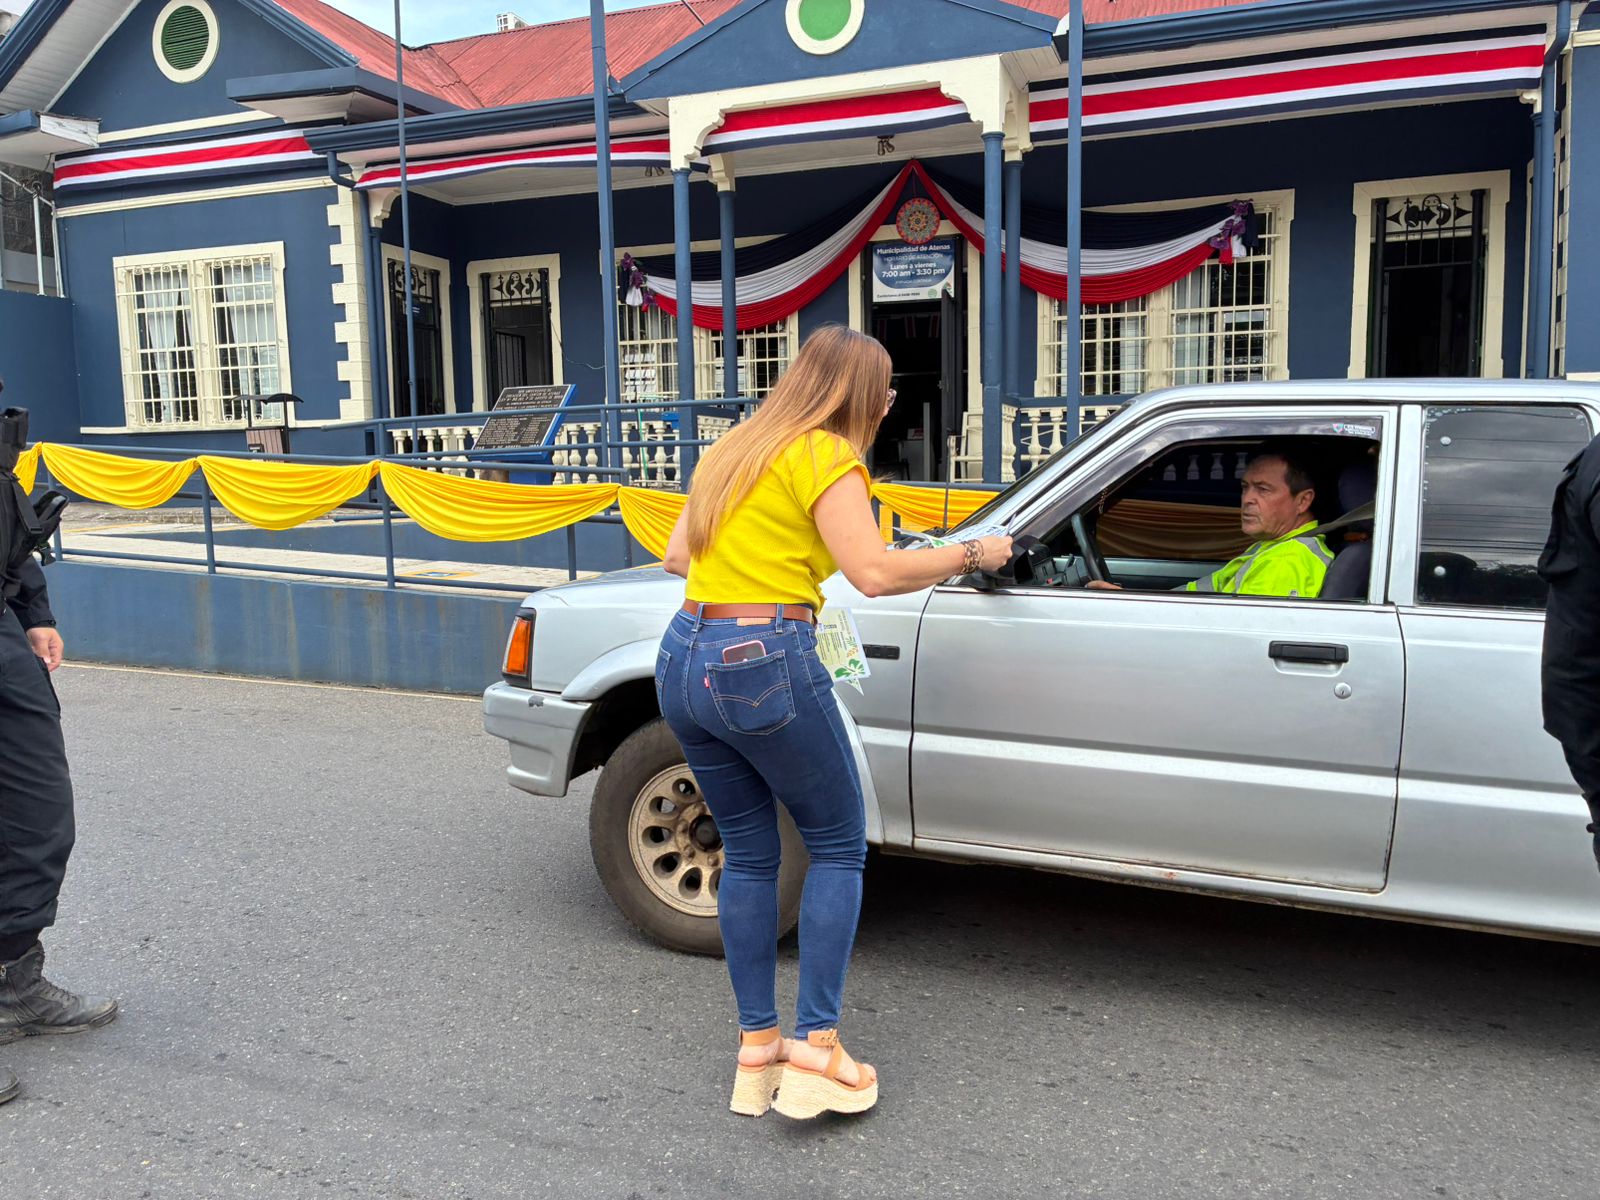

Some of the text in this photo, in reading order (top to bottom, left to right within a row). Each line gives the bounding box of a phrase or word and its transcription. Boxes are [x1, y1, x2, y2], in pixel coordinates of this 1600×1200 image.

[876, 245, 919, 254] Municipalidad
[881, 270, 898, 278] 7:00
[916, 268, 932, 276] 3:30
[932, 268, 946, 276] pm
